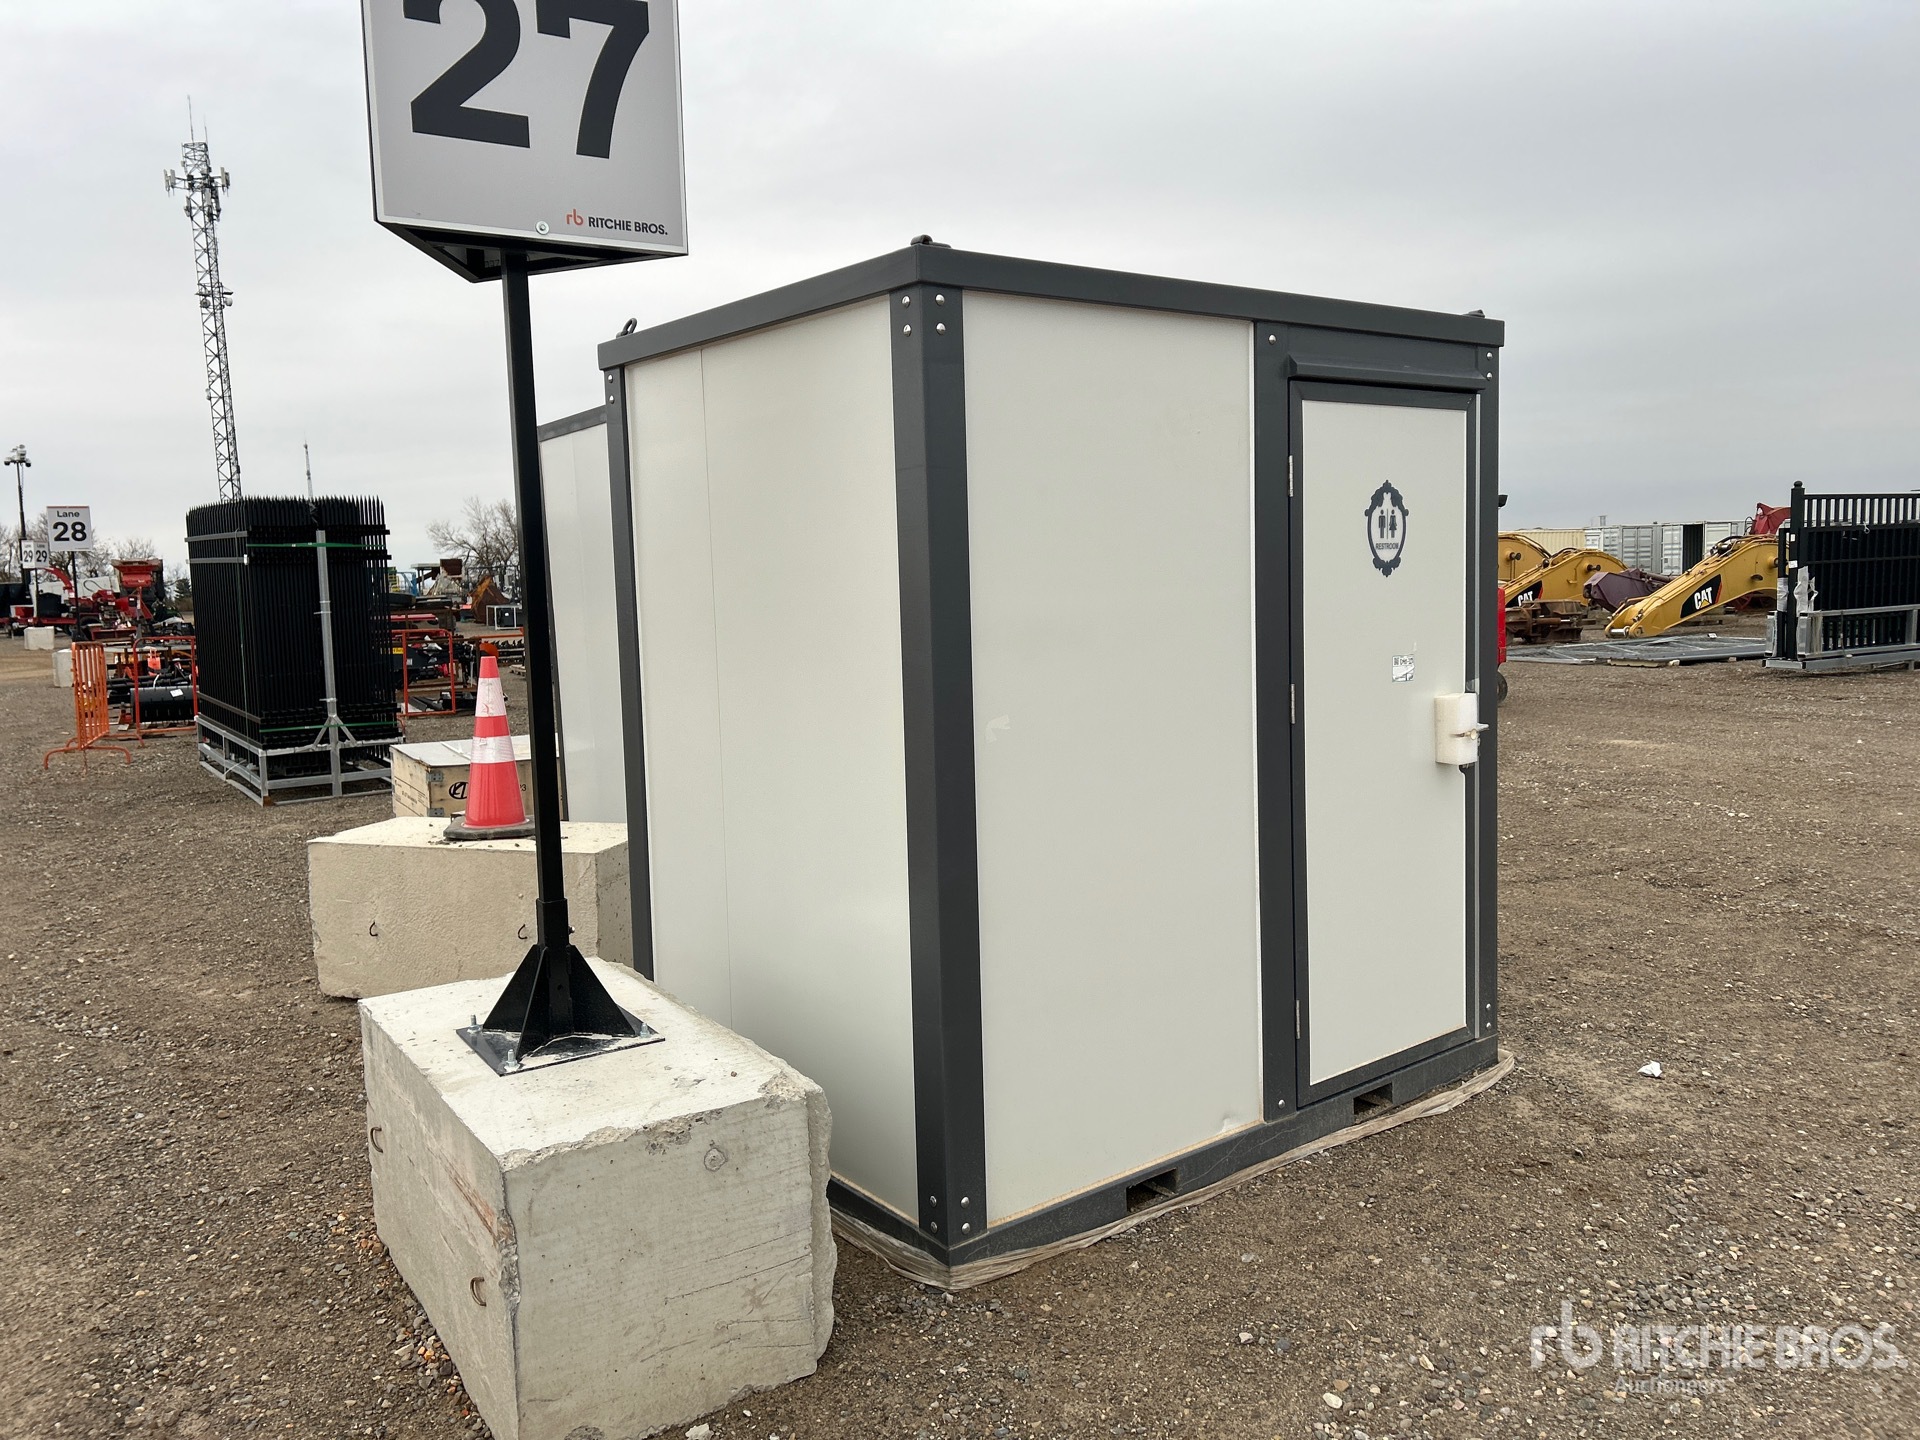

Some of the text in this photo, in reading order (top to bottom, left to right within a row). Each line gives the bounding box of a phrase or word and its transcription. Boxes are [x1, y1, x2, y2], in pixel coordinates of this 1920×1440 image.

[402, 0, 650, 159] 27
[566, 208, 668, 236] rb RITCHIE BROS.
[57, 510, 80, 518] Lane
[52, 521, 87, 542] 28
[1375, 542, 1399, 550] RESTROOM
[23, 550, 34, 563] 29
[35, 550, 48, 563] 29
[1517, 590, 1534, 607] CAT
[1694, 586, 1713, 610] CAT
